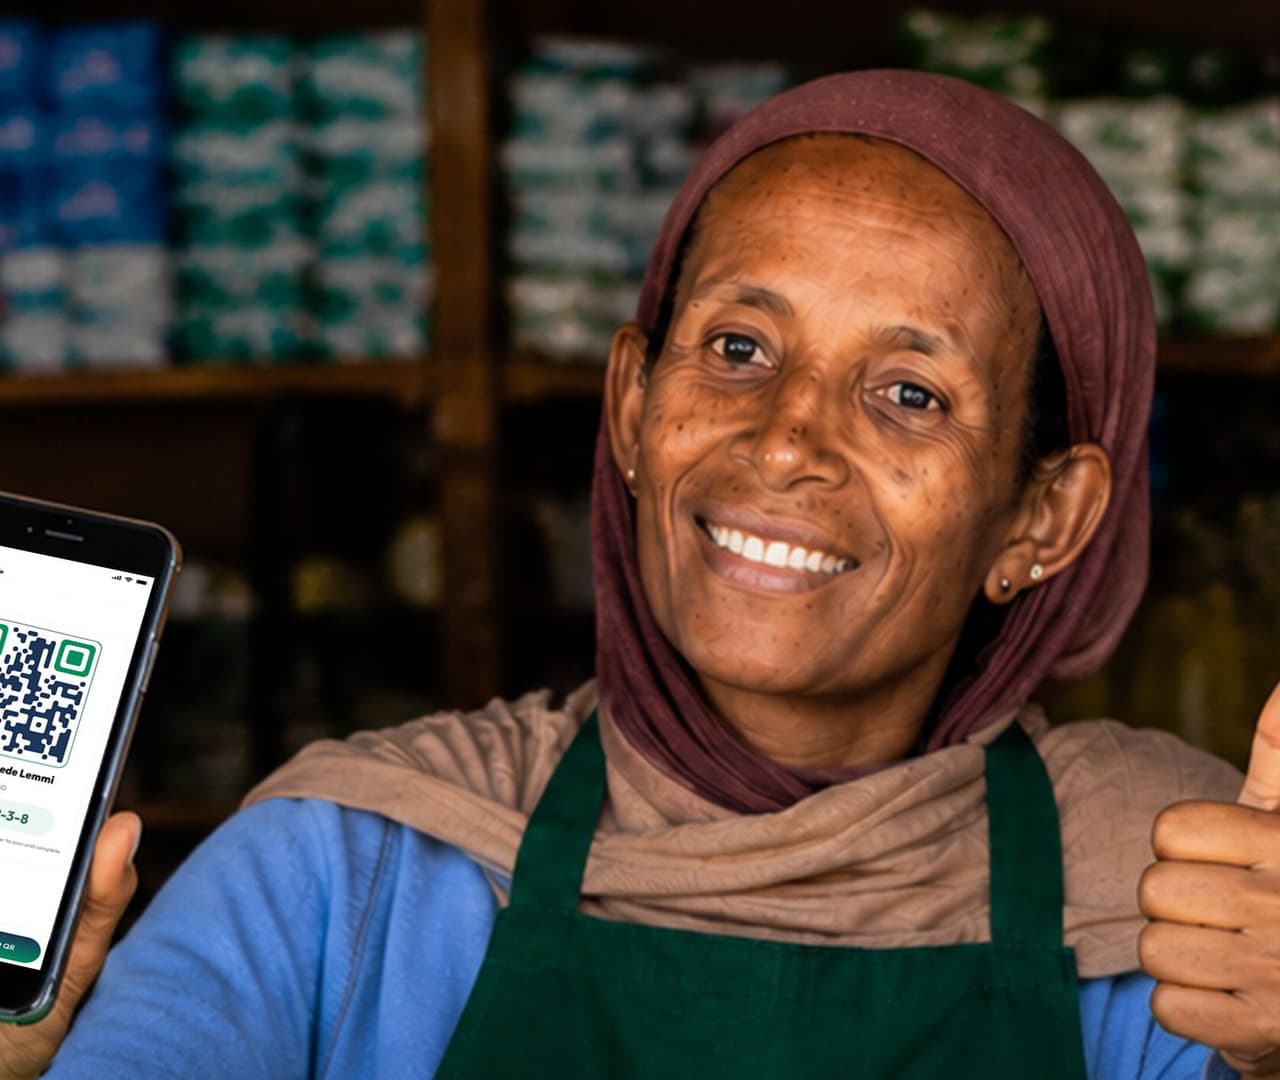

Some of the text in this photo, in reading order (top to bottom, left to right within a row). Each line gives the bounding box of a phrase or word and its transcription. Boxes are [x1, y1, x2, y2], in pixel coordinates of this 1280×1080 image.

[19, 768, 55, 784] Lemmi
[0, 783, 7, 791] ID
[2, 942, 16, 951] QR
